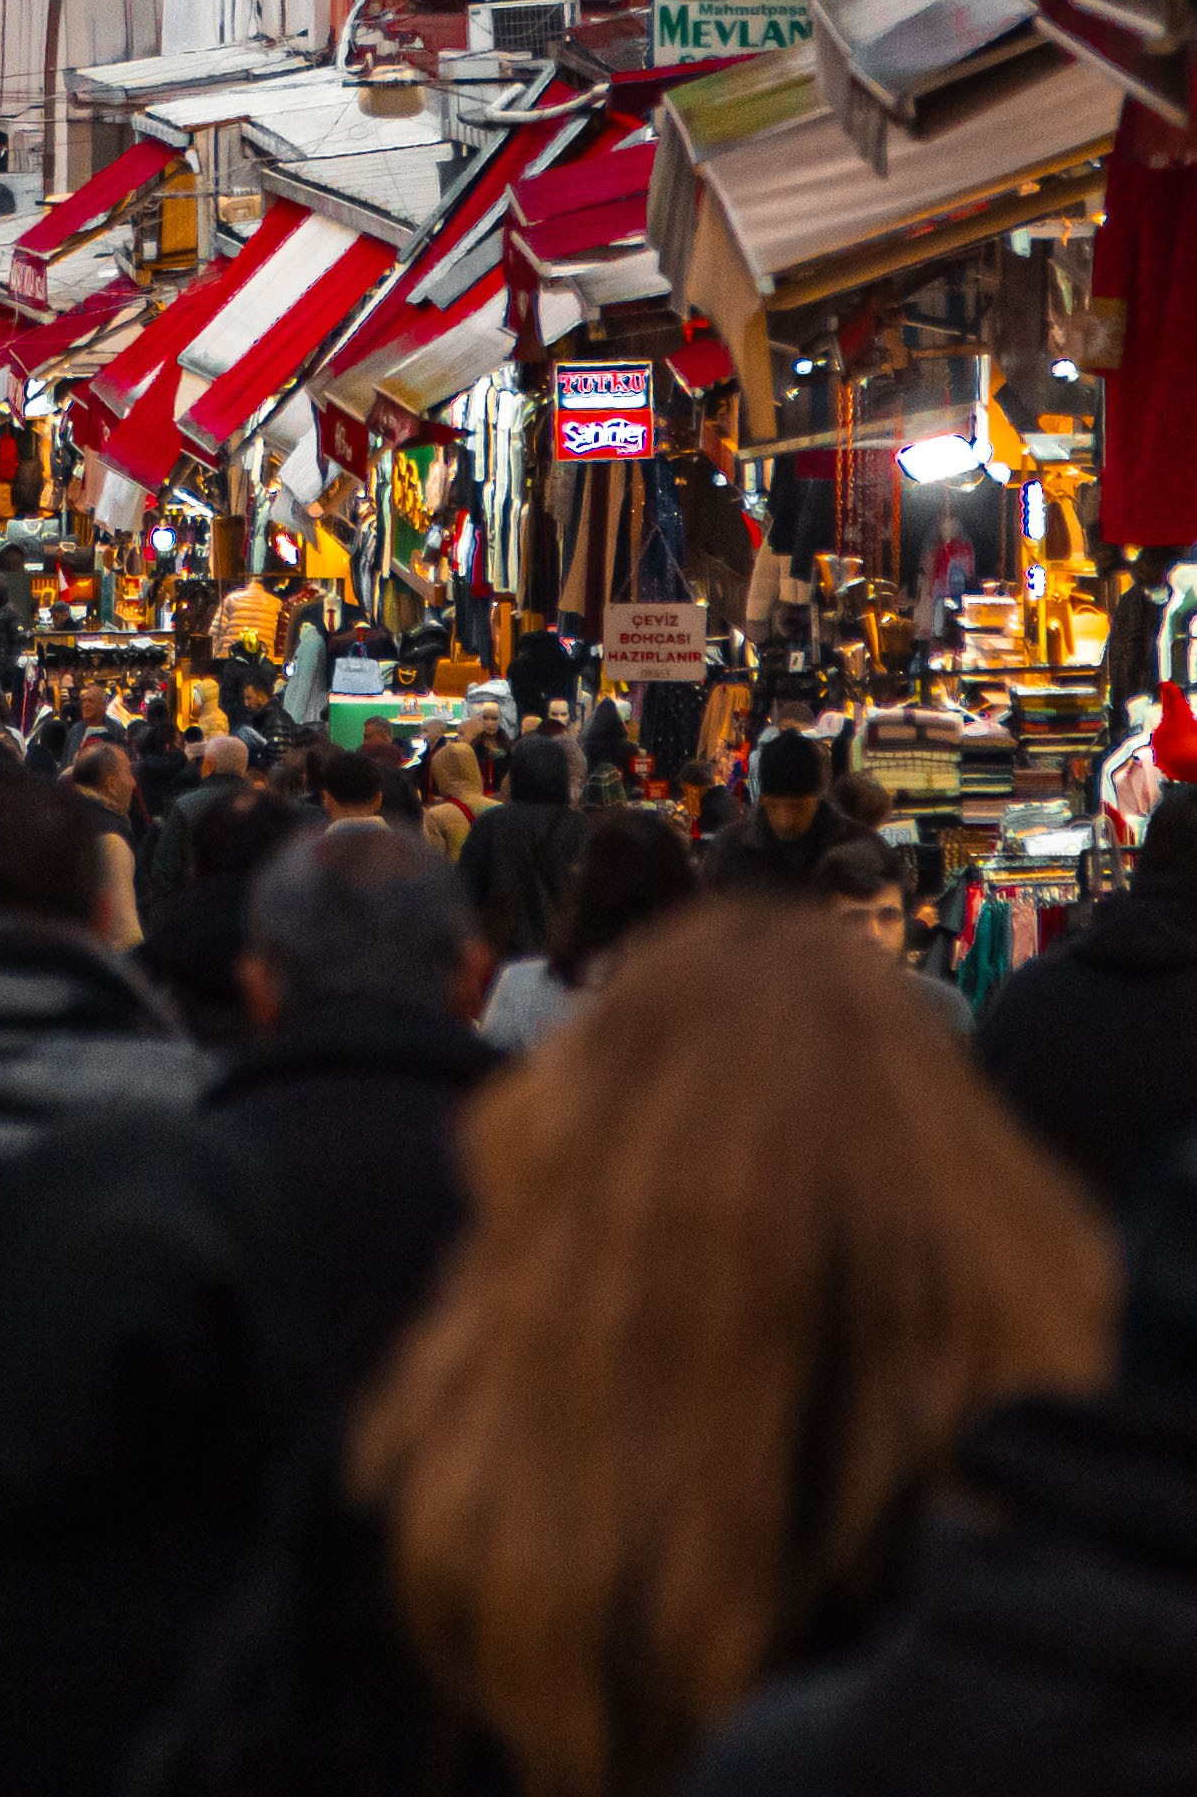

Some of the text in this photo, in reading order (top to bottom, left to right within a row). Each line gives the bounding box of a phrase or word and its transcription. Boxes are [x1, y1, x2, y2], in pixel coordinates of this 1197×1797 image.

[559, 371, 646, 394] TUTKU
[632, 612, 679, 629] ÇEYİZ
[608, 651, 702, 663] HAZIRLANIR
